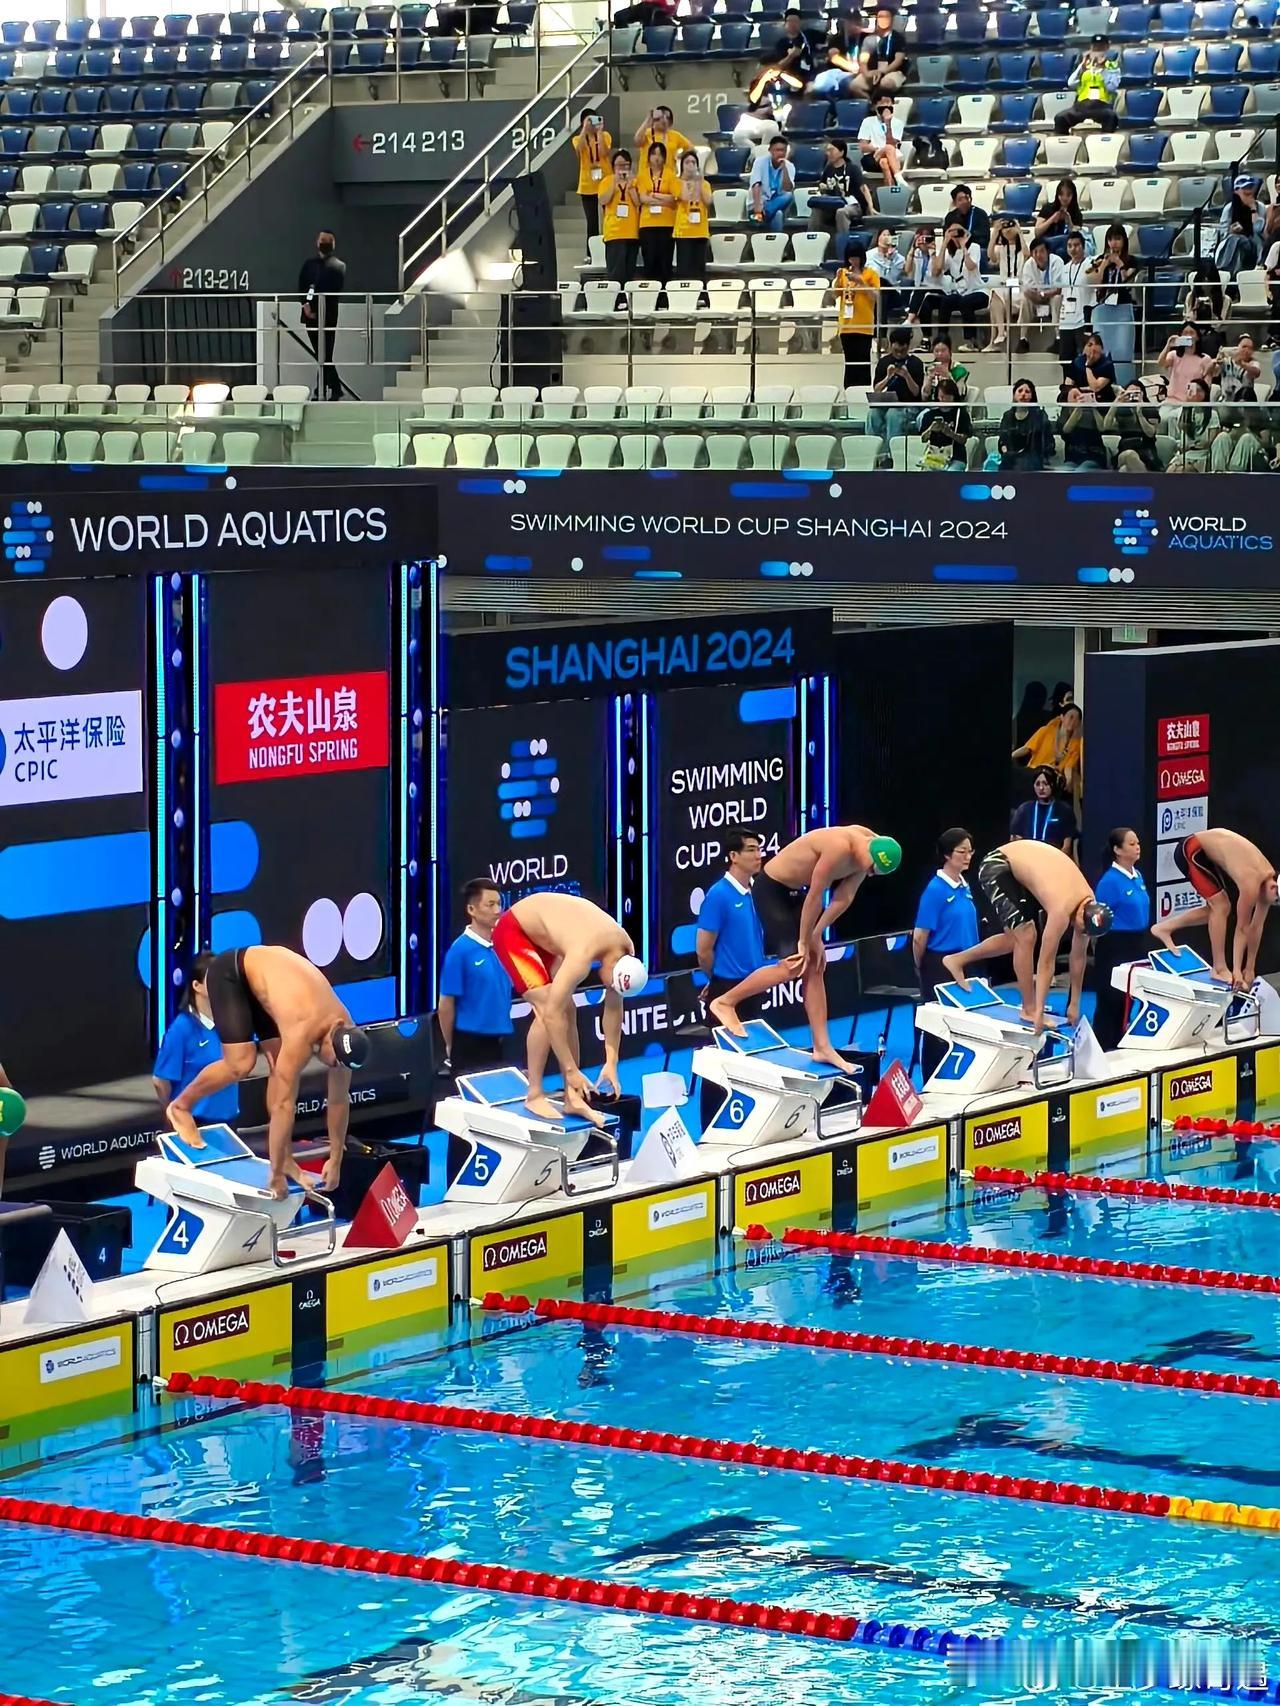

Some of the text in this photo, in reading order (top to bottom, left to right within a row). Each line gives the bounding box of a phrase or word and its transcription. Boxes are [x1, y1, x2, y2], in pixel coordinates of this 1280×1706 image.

[372, 129, 465, 154] 214 213
[183, 267, 249, 291] 213-214
[70, 507, 388, 552] WORLD AQUATICS
[510, 513, 1009, 539] SWIMMING WORLD CUP SHANGHAI 2024
[1168, 516, 1247, 532] WORLD
[1168, 534, 1273, 551] AQUATICS
[505, 627, 795, 688] SHANGHAI 2024
[247, 686, 358, 739] 农夫山泉
[14, 715, 126, 754] 太平洋保险
[248, 738, 358, 769] NONGFU SPRING
[15, 759, 58, 782] CPIC
[671, 757, 784, 794] SWIMMING
[1172, 769, 1205, 787] OMEGA
[689, 797, 767, 830] WORLD
[675, 841, 721, 869] CUP
[489, 854, 568, 885] WORLD
[1145, 1011, 1158, 1033] 8
[951, 1052, 965, 1076] 7
[1003, 1056, 1024, 1079] 7
[1180, 1075, 1212, 1095] OMEGA
[729, 1099, 745, 1123] 6
[784, 1105, 806, 1129] 6
[985, 1120, 1022, 1144] OMEGA
[61, 1140, 108, 1160] WORLD
[474, 1154, 489, 1181] 5
[534, 1159, 559, 1186] 5
[758, 1175, 801, 1199] OMEGA
[172, 1220, 189, 1249] 4
[241, 1224, 267, 1252] 4
[98, 1247, 106, 1263] 4
[499, 1237, 548, 1264] OMEGA
[193, 1311, 249, 1341] OMEGA
